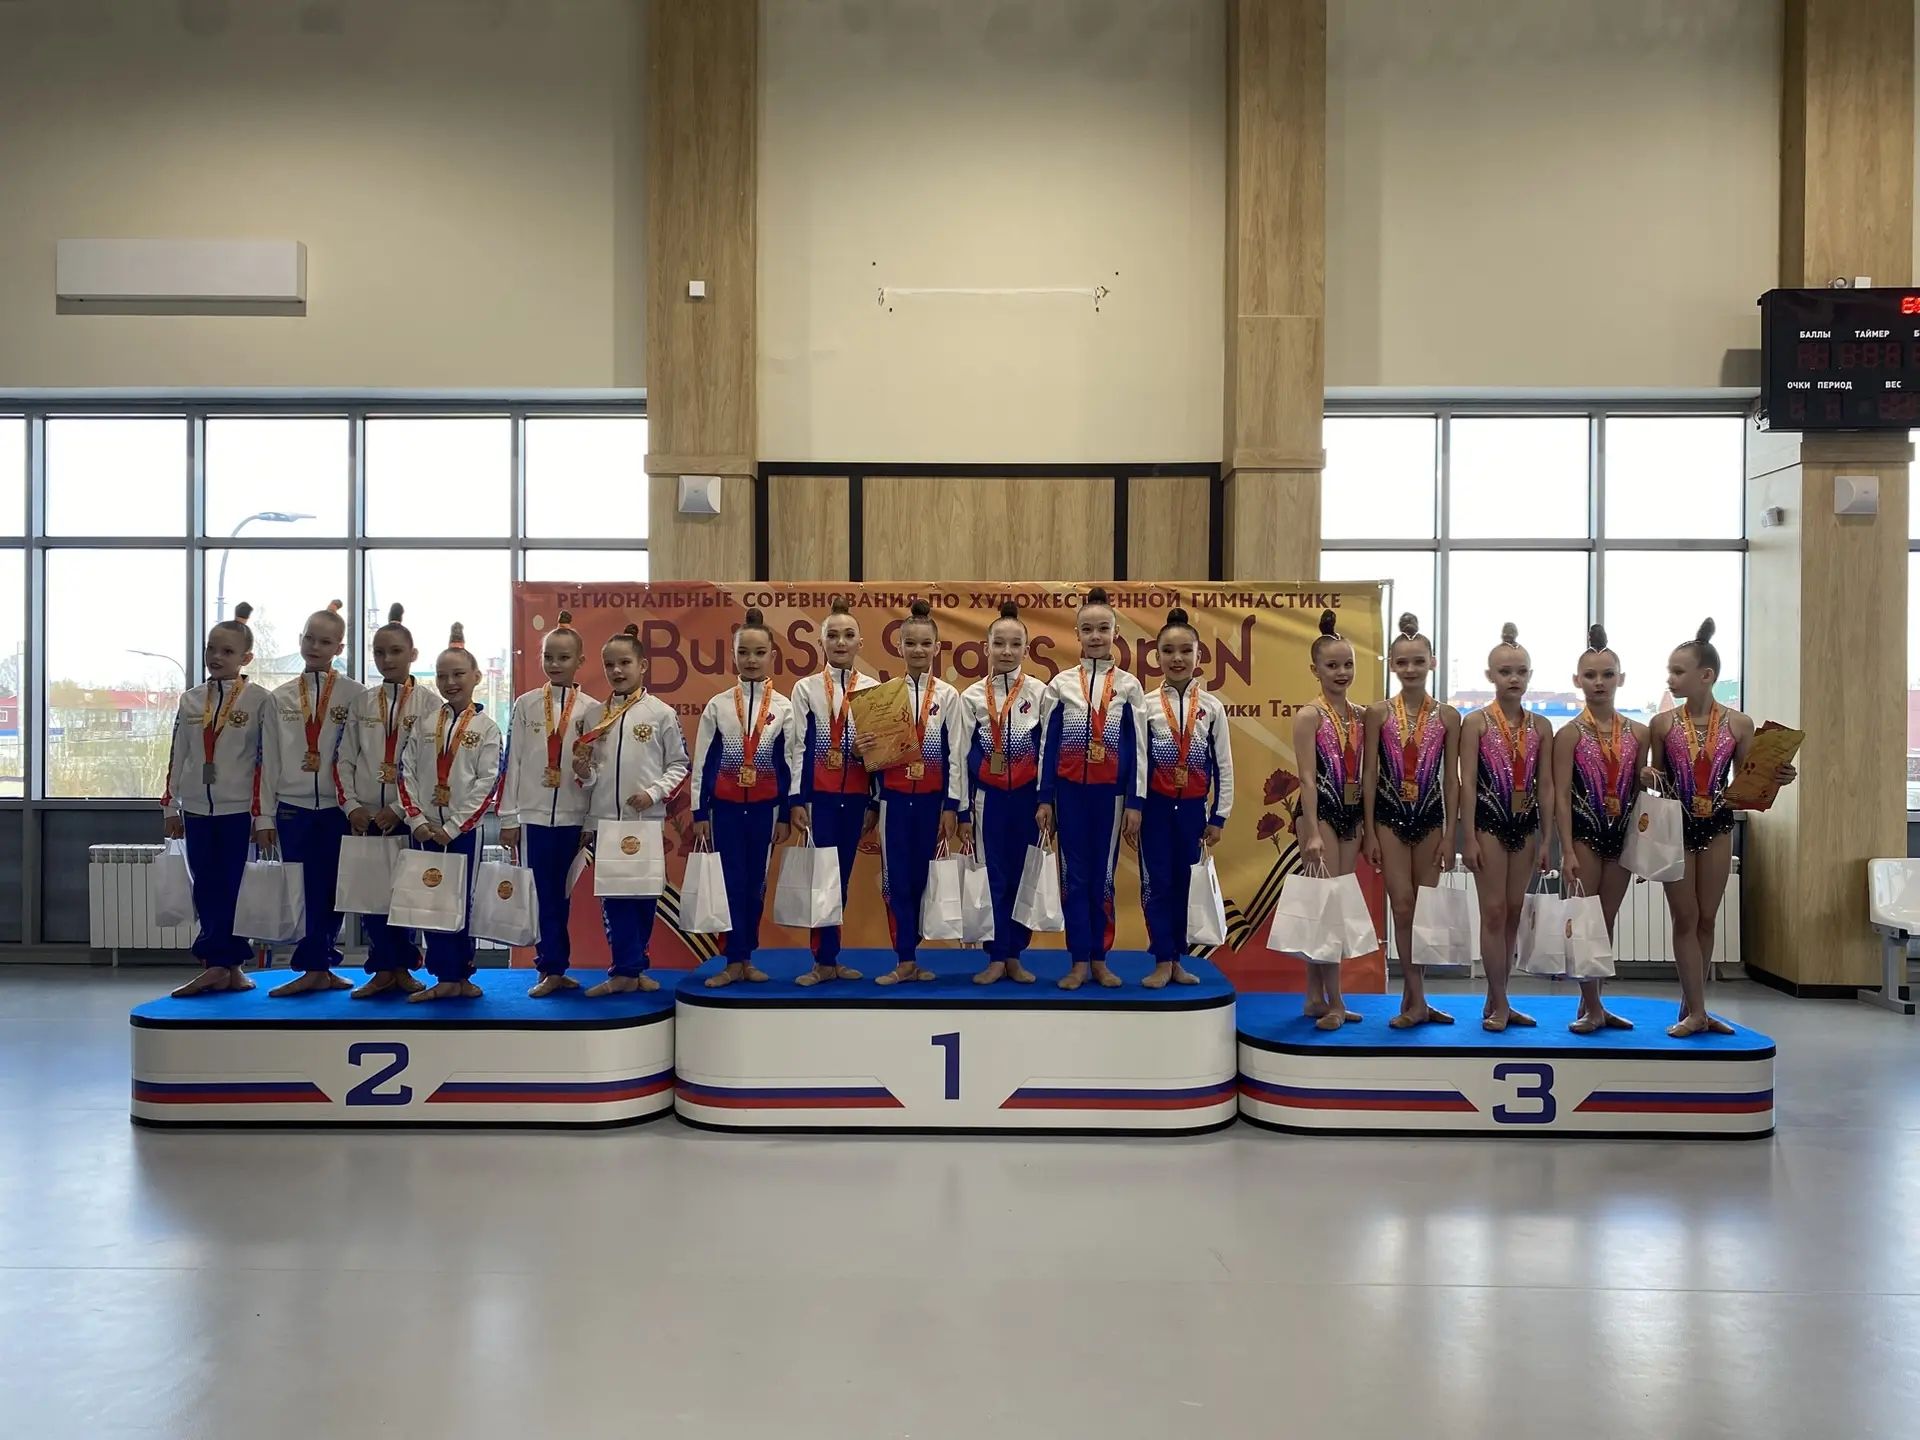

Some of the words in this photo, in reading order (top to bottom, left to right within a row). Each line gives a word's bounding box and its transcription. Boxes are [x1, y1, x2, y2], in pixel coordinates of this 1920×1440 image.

[1799, 330, 1831, 339] БАЛЛЫ
[1854, 328, 1890, 338] ТАЙМЕР
[1787, 381, 1811, 389] ОЧКИ
[1817, 381, 1853, 390] ПЕРИОД
[1885, 380, 1902, 389] ВЕС
[557, 592, 733, 609] РЕГИОНАЛЬНЫЕ
[928, 592, 960, 609] ПО
[969, 590, 1181, 610] ХУДОЖЕСТЕННОЙ
[1191, 592, 1342, 609] ГИМНАСТИКЕ
[345, 1041, 413, 1107] 2
[930, 1031, 961, 1101] 1
[1492, 1062, 1557, 1124] 3
